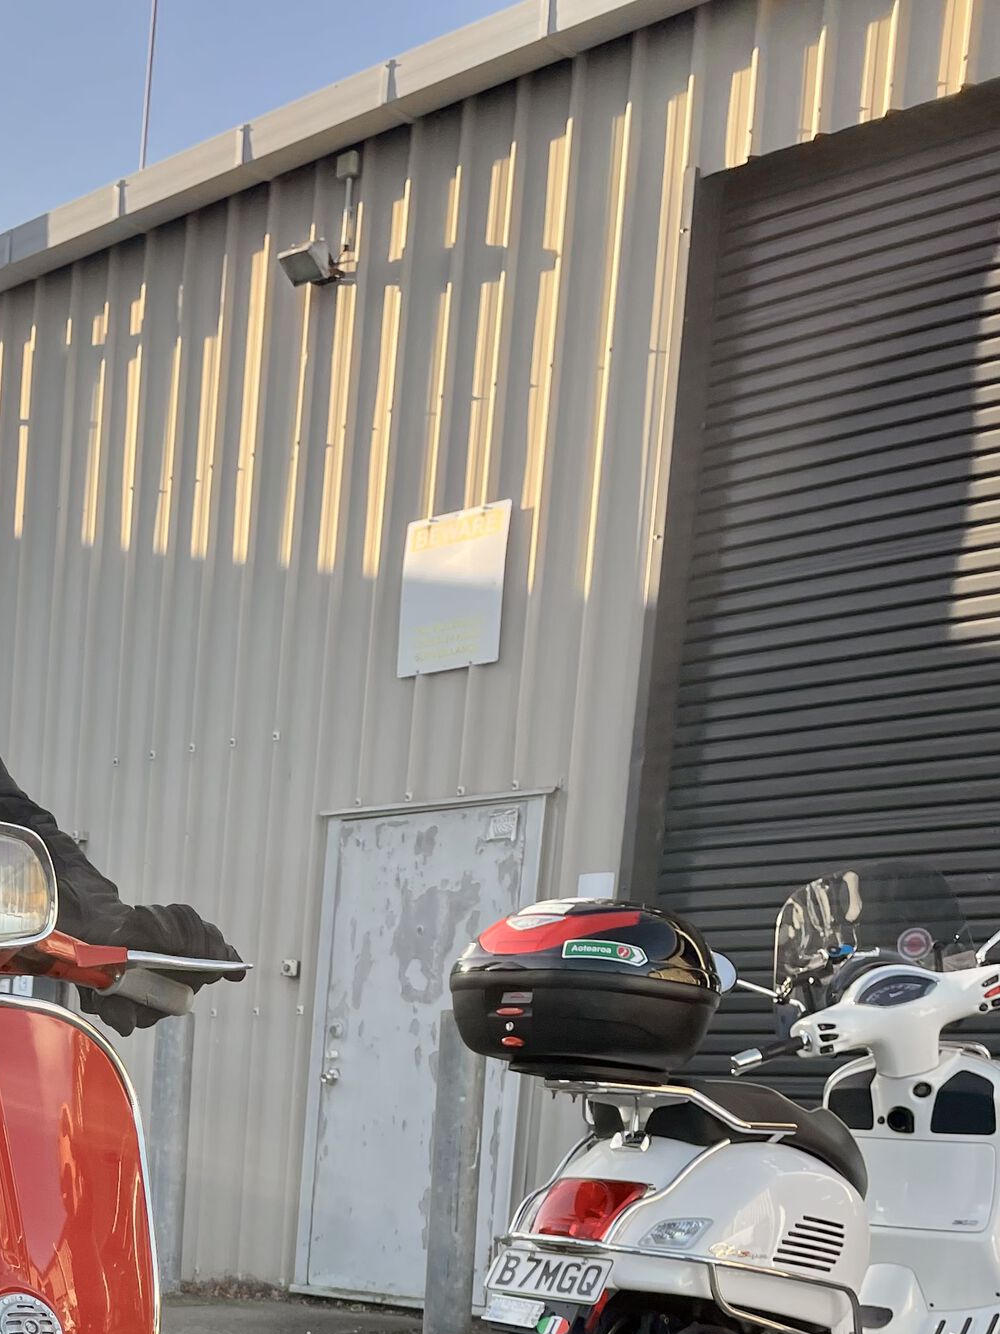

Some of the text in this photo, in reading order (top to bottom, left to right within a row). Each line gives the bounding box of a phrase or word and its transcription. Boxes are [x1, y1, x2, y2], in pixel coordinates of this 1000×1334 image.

[415, 513, 497, 550] BEWARE
[571, 944, 612, 954] Aotearoa
[495, 1255, 603, 1296] B7MGQ
